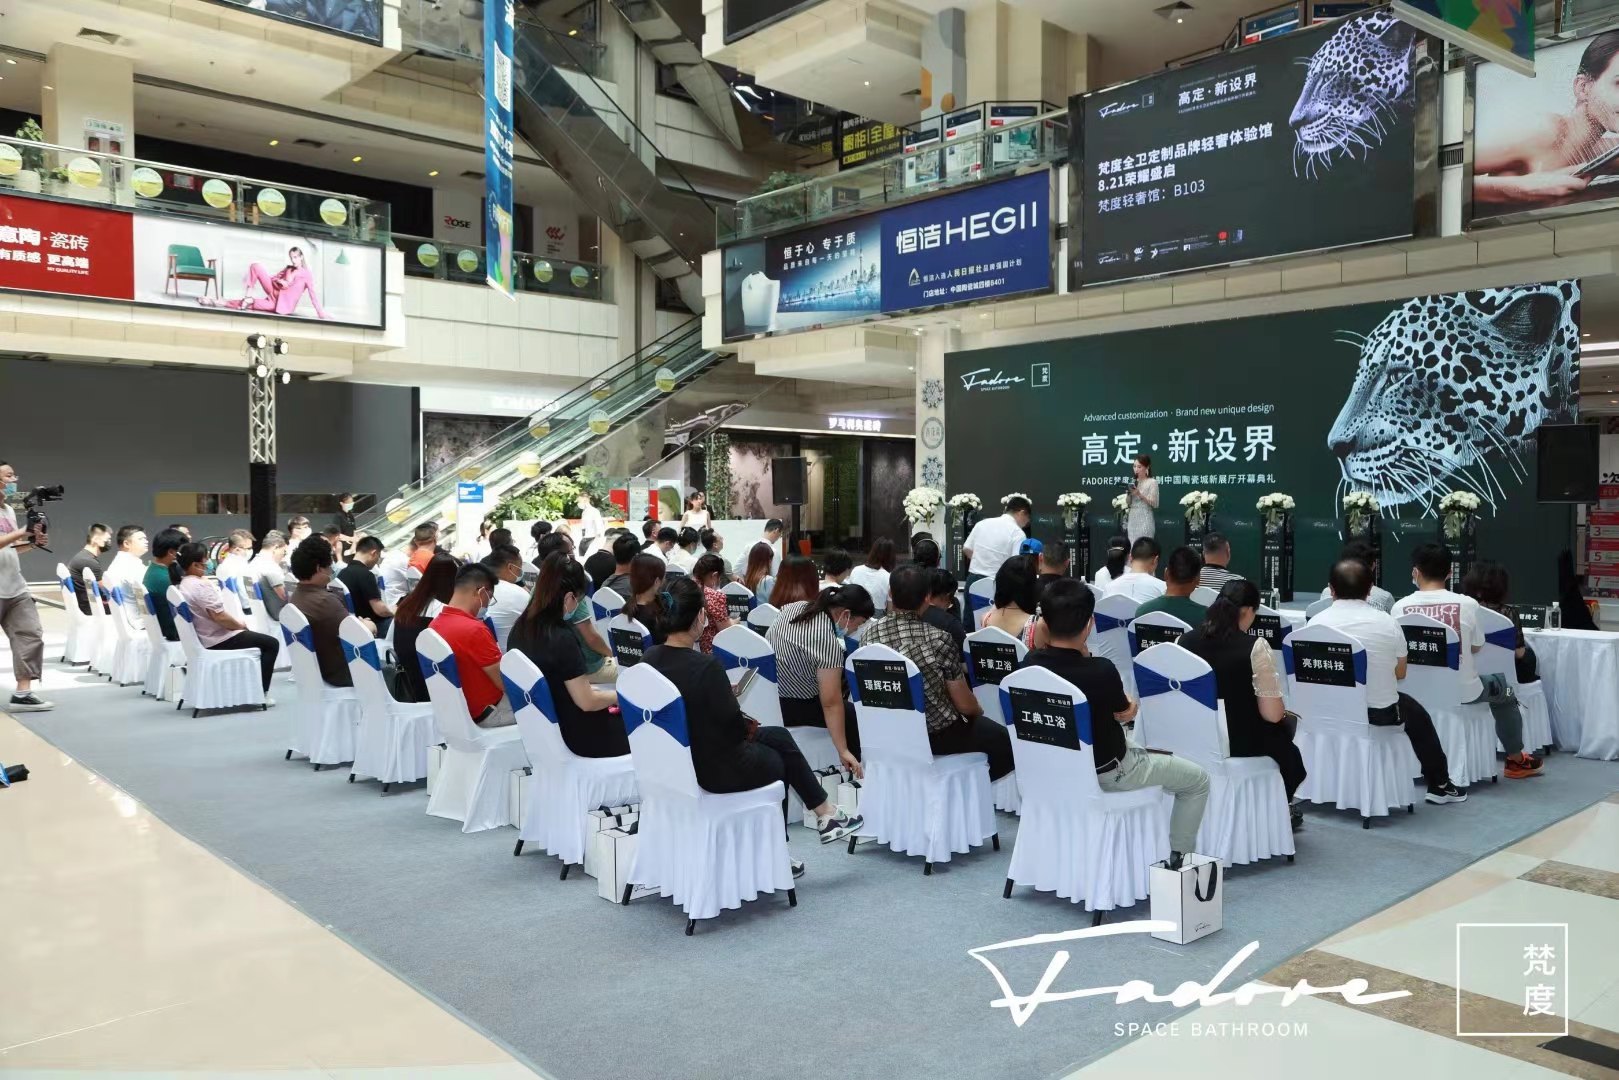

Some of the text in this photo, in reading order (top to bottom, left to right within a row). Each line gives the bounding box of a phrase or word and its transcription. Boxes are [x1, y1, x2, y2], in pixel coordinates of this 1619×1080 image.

[1178, 72, 1257, 106] 高定·新设界
[1098, 122, 1273, 176] 梵度全卫定制品牌轻奢体验馆
[1098, 164, 1175, 192] 8.21荣耀盛启
[896, 201, 1037, 254] 恒洁 HEGII
[783, 231, 856, 259] 恒于心 专于质
[1083, 403, 1275, 422] Advanced customization Brand new unique design
[1081, 425, 1277, 466] 高定·新设界
[1248, 628, 1274, 638] 山日报
[1408, 640, 1439, 653] 瓷资讯
[1021, 710, 1066, 729] 工典卫浴
